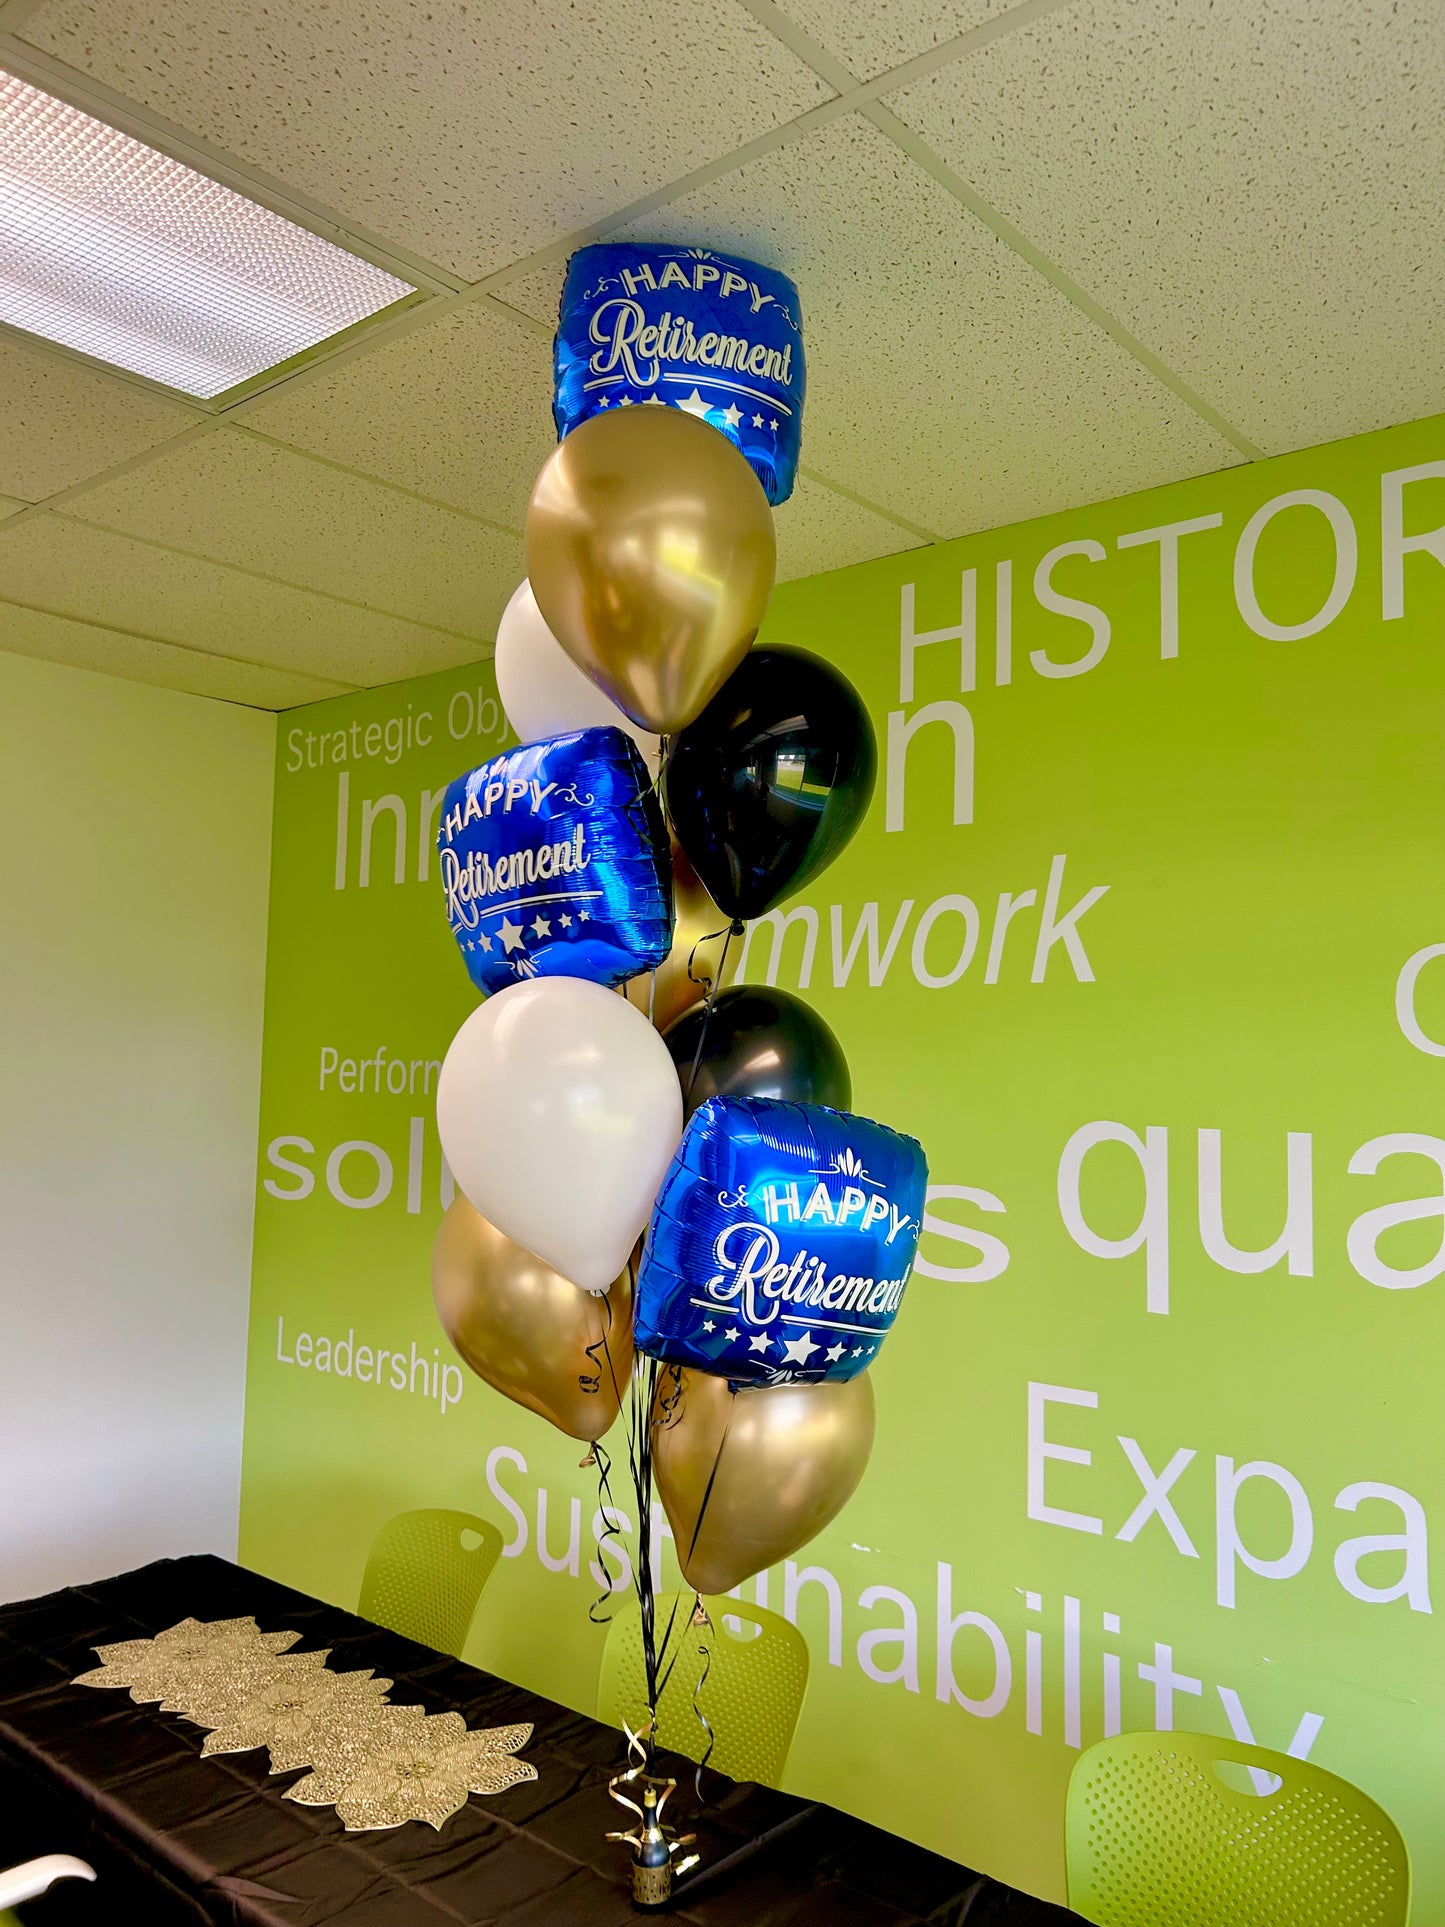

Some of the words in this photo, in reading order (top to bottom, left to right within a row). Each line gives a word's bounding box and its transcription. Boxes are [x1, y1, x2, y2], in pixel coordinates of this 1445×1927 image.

[619, 261, 775, 314] HAPPY
[588, 298, 794, 387] Retirement
[899, 459, 1445, 704] HISTOR
[286, 703, 433, 772] Strategic
[445, 778, 558, 844] HAPPY
[439, 823, 592, 929] Retirement
[263, 1117, 455, 1214] sol
[762, 1182, 911, 1246] HAPPY
[1057, 1120, 1445, 1315] qua
[705, 1222, 912, 1326] Retirement
[276, 1316, 464, 1414] Leadership
[1027, 1381, 1433, 1615] Expa
